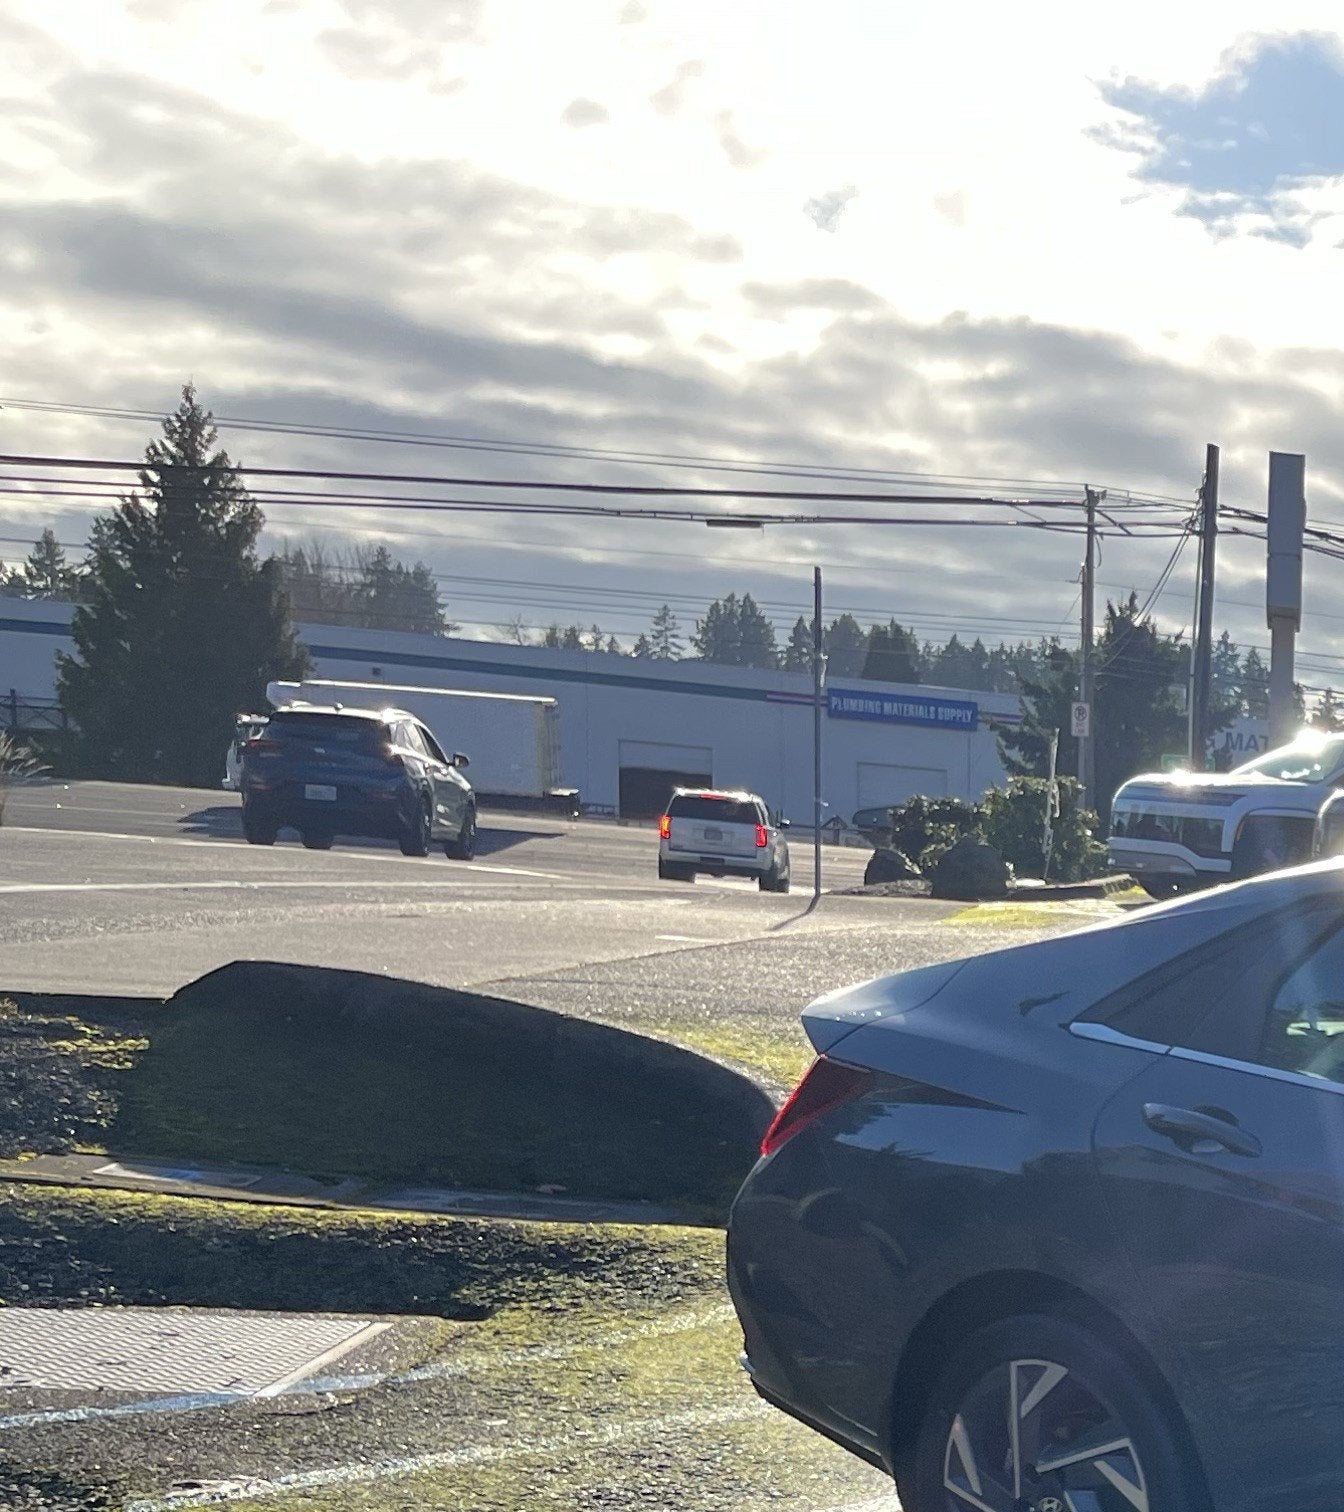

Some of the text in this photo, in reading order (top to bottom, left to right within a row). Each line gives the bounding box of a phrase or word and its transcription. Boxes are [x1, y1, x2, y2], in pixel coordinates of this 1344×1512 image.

[831, 696, 973, 723] PLUMBING MATERIALS SUPPLY
